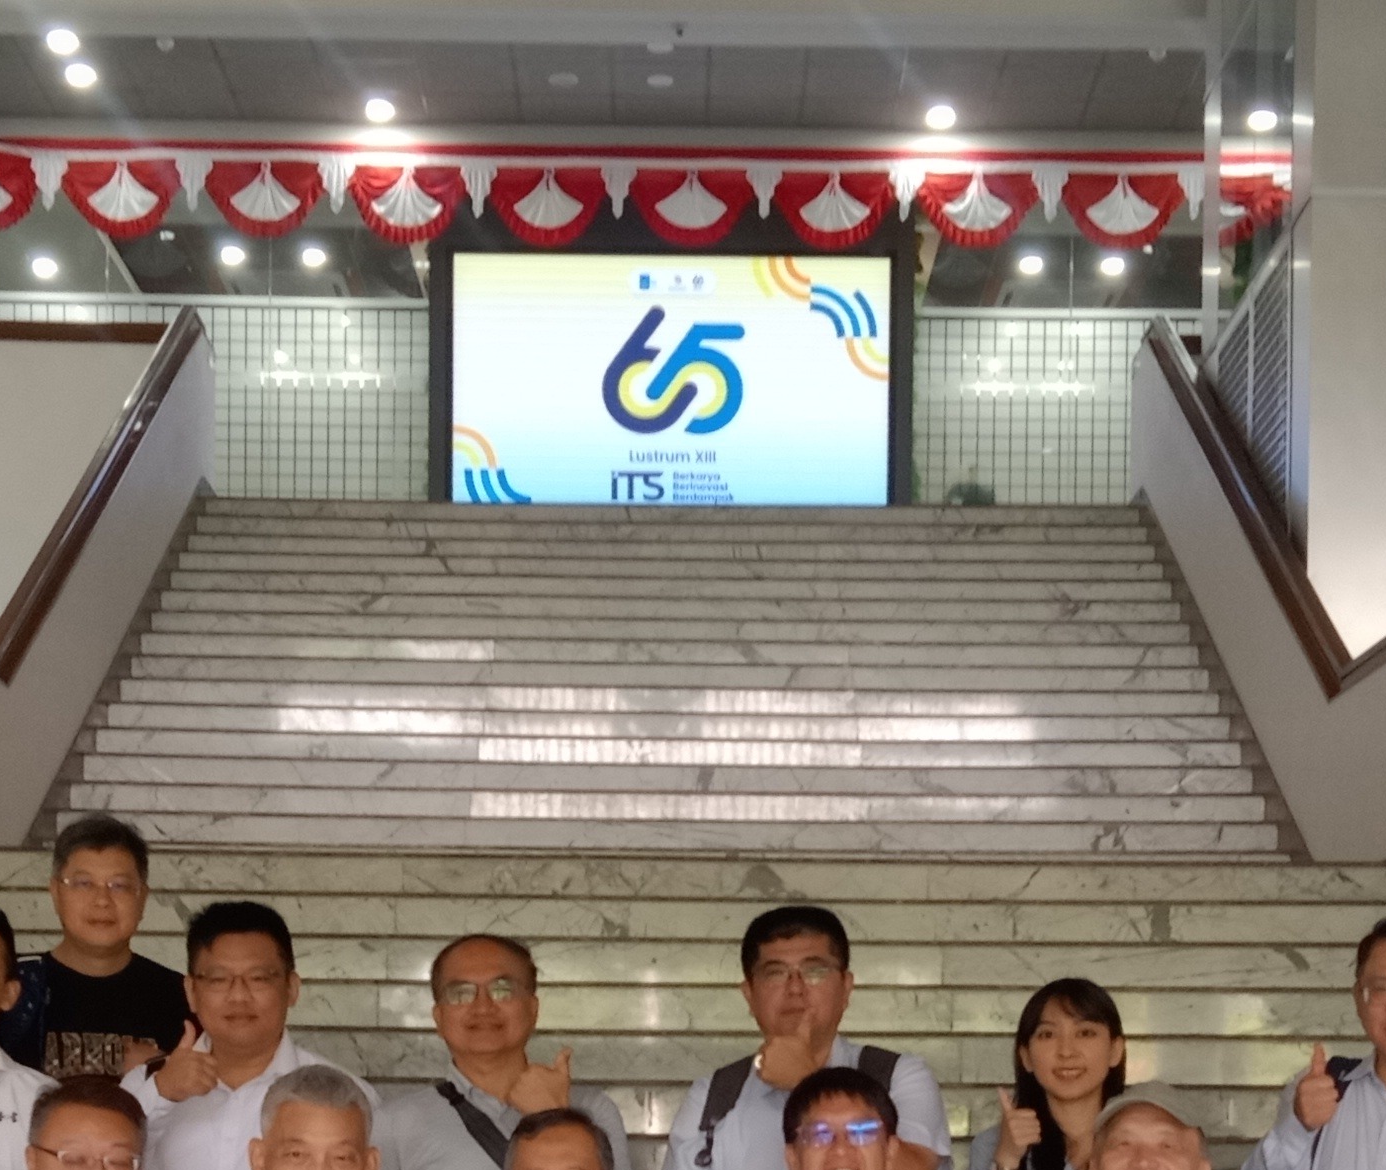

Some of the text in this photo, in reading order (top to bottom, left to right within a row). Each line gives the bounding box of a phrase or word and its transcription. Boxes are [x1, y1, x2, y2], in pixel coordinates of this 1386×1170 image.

[601, 304, 746, 434] 65
[629, 449, 717, 463] Lustrum XIII
